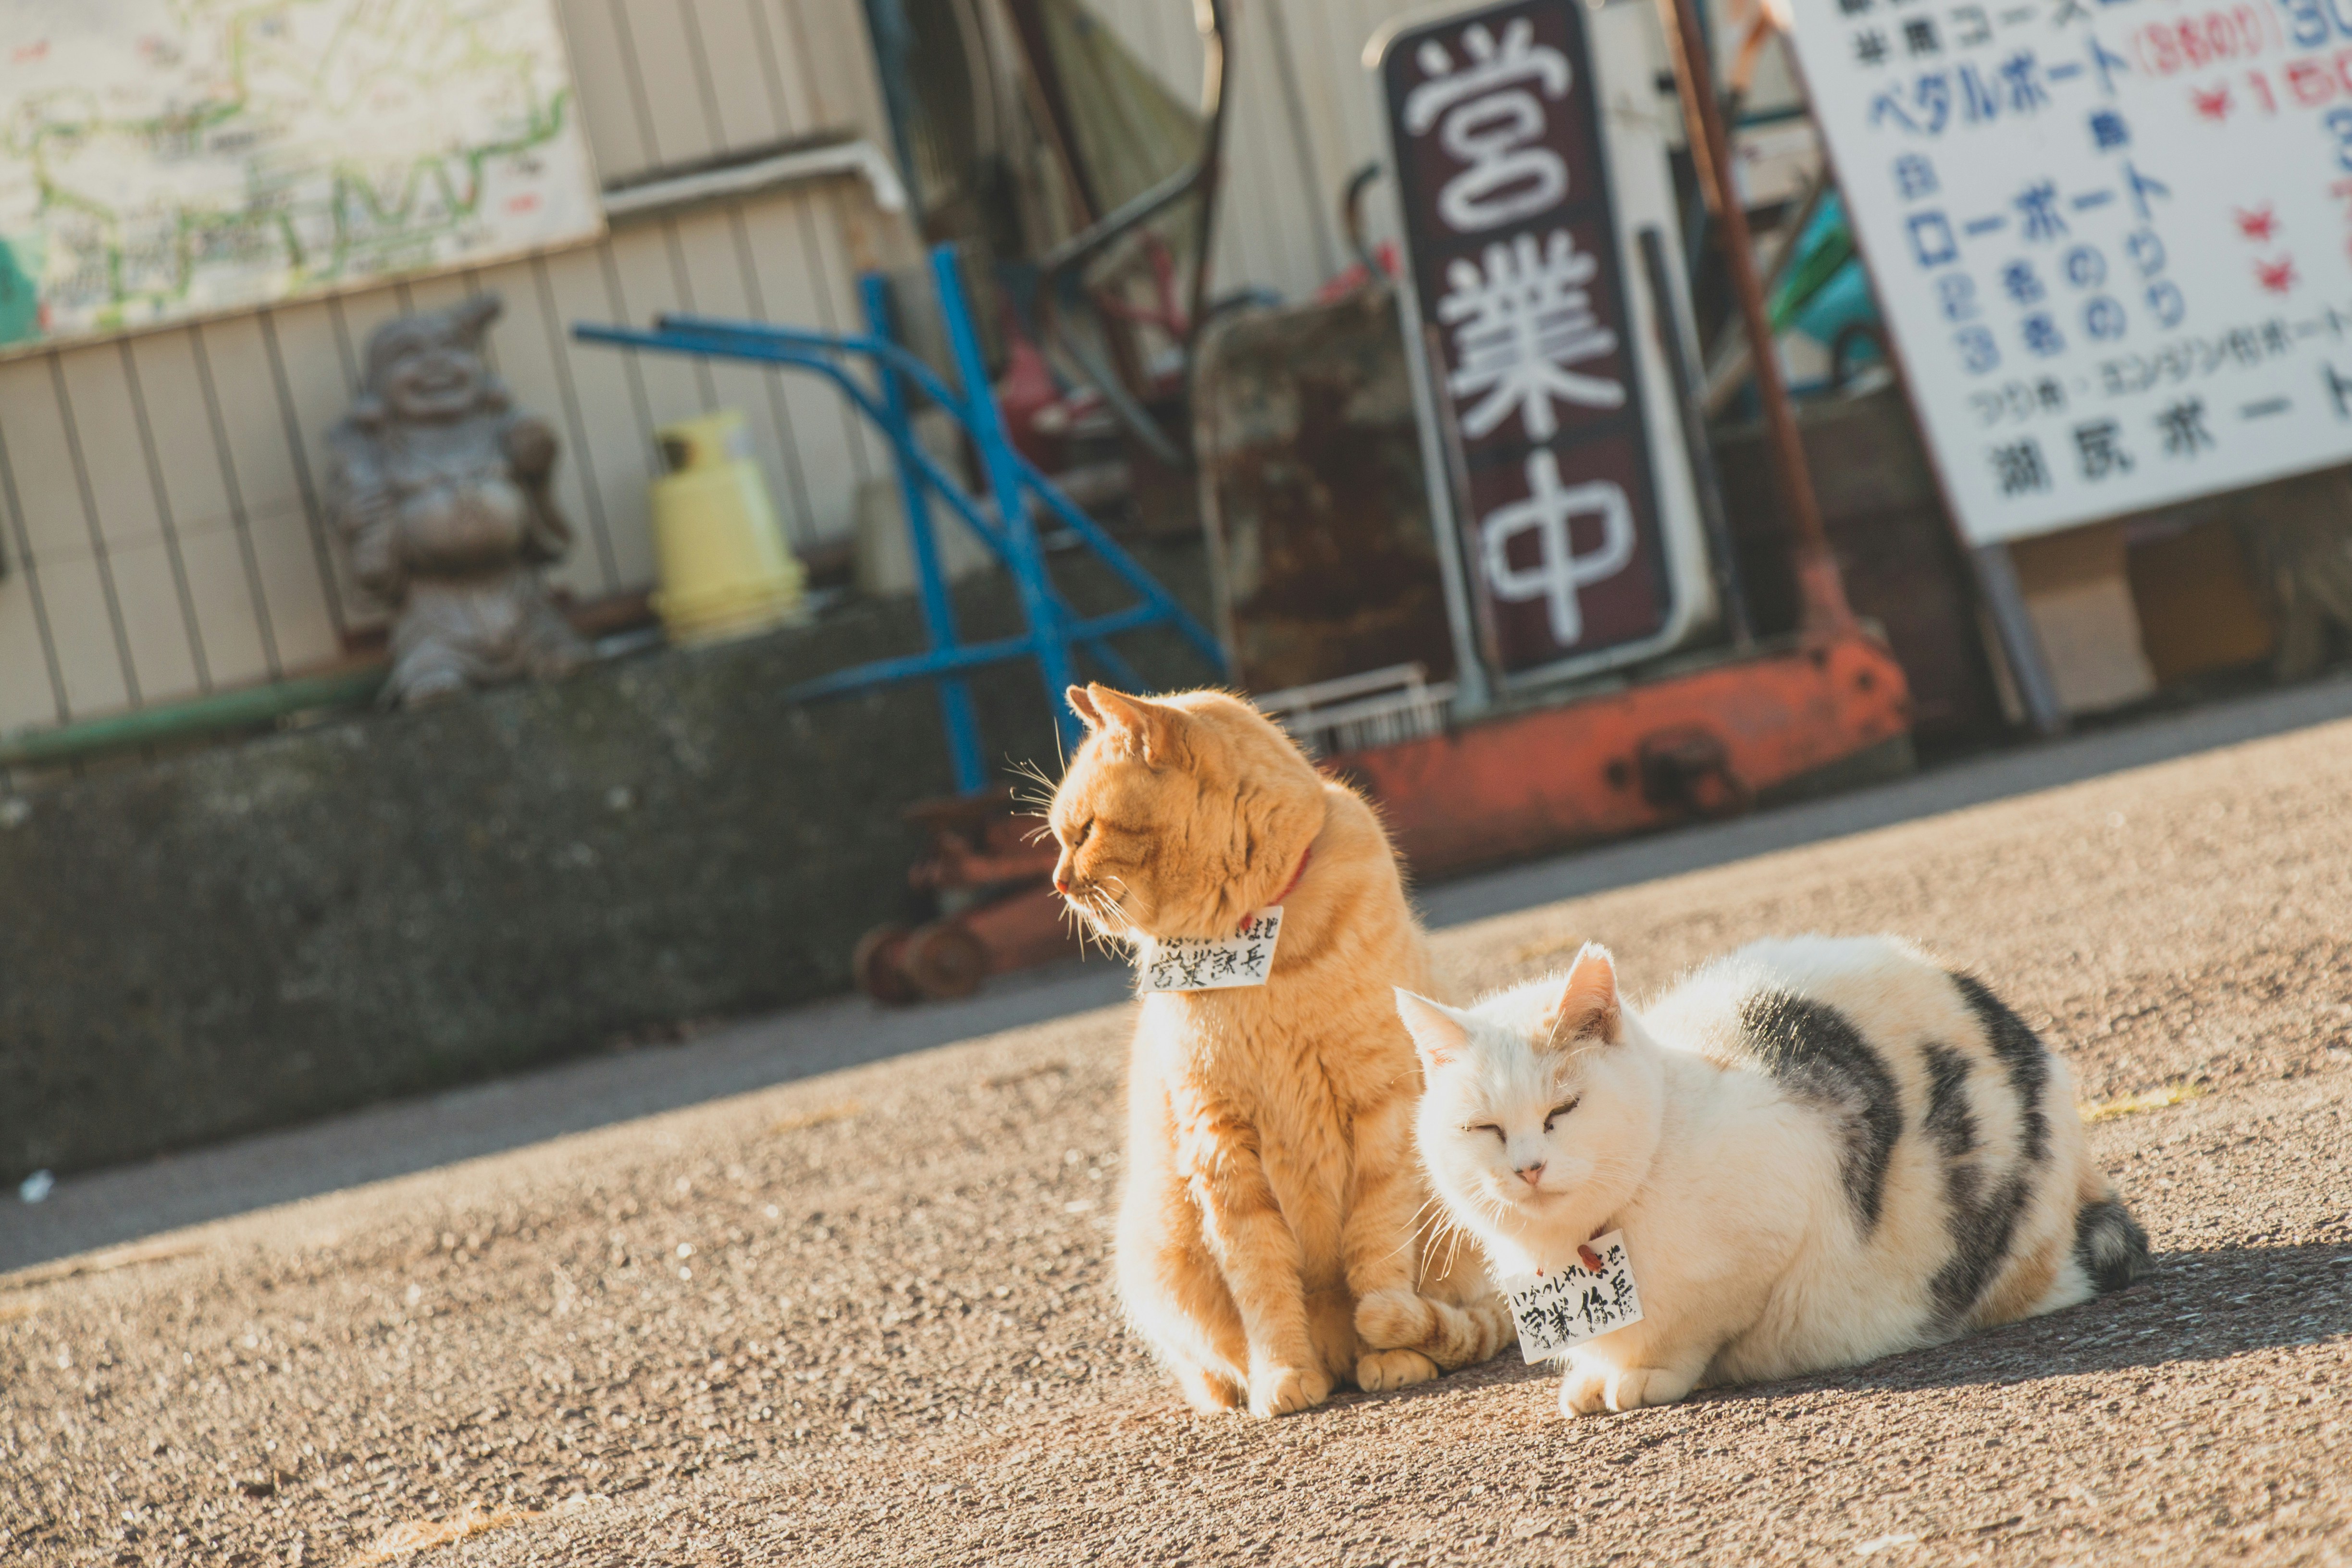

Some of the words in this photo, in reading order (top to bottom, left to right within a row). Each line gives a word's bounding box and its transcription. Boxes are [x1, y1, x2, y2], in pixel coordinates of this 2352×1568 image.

[1905, 158, 2172, 270] ローボート
[1403, 17, 1635, 645] 営業中
[1150, 944, 1265, 988] 営業課長
